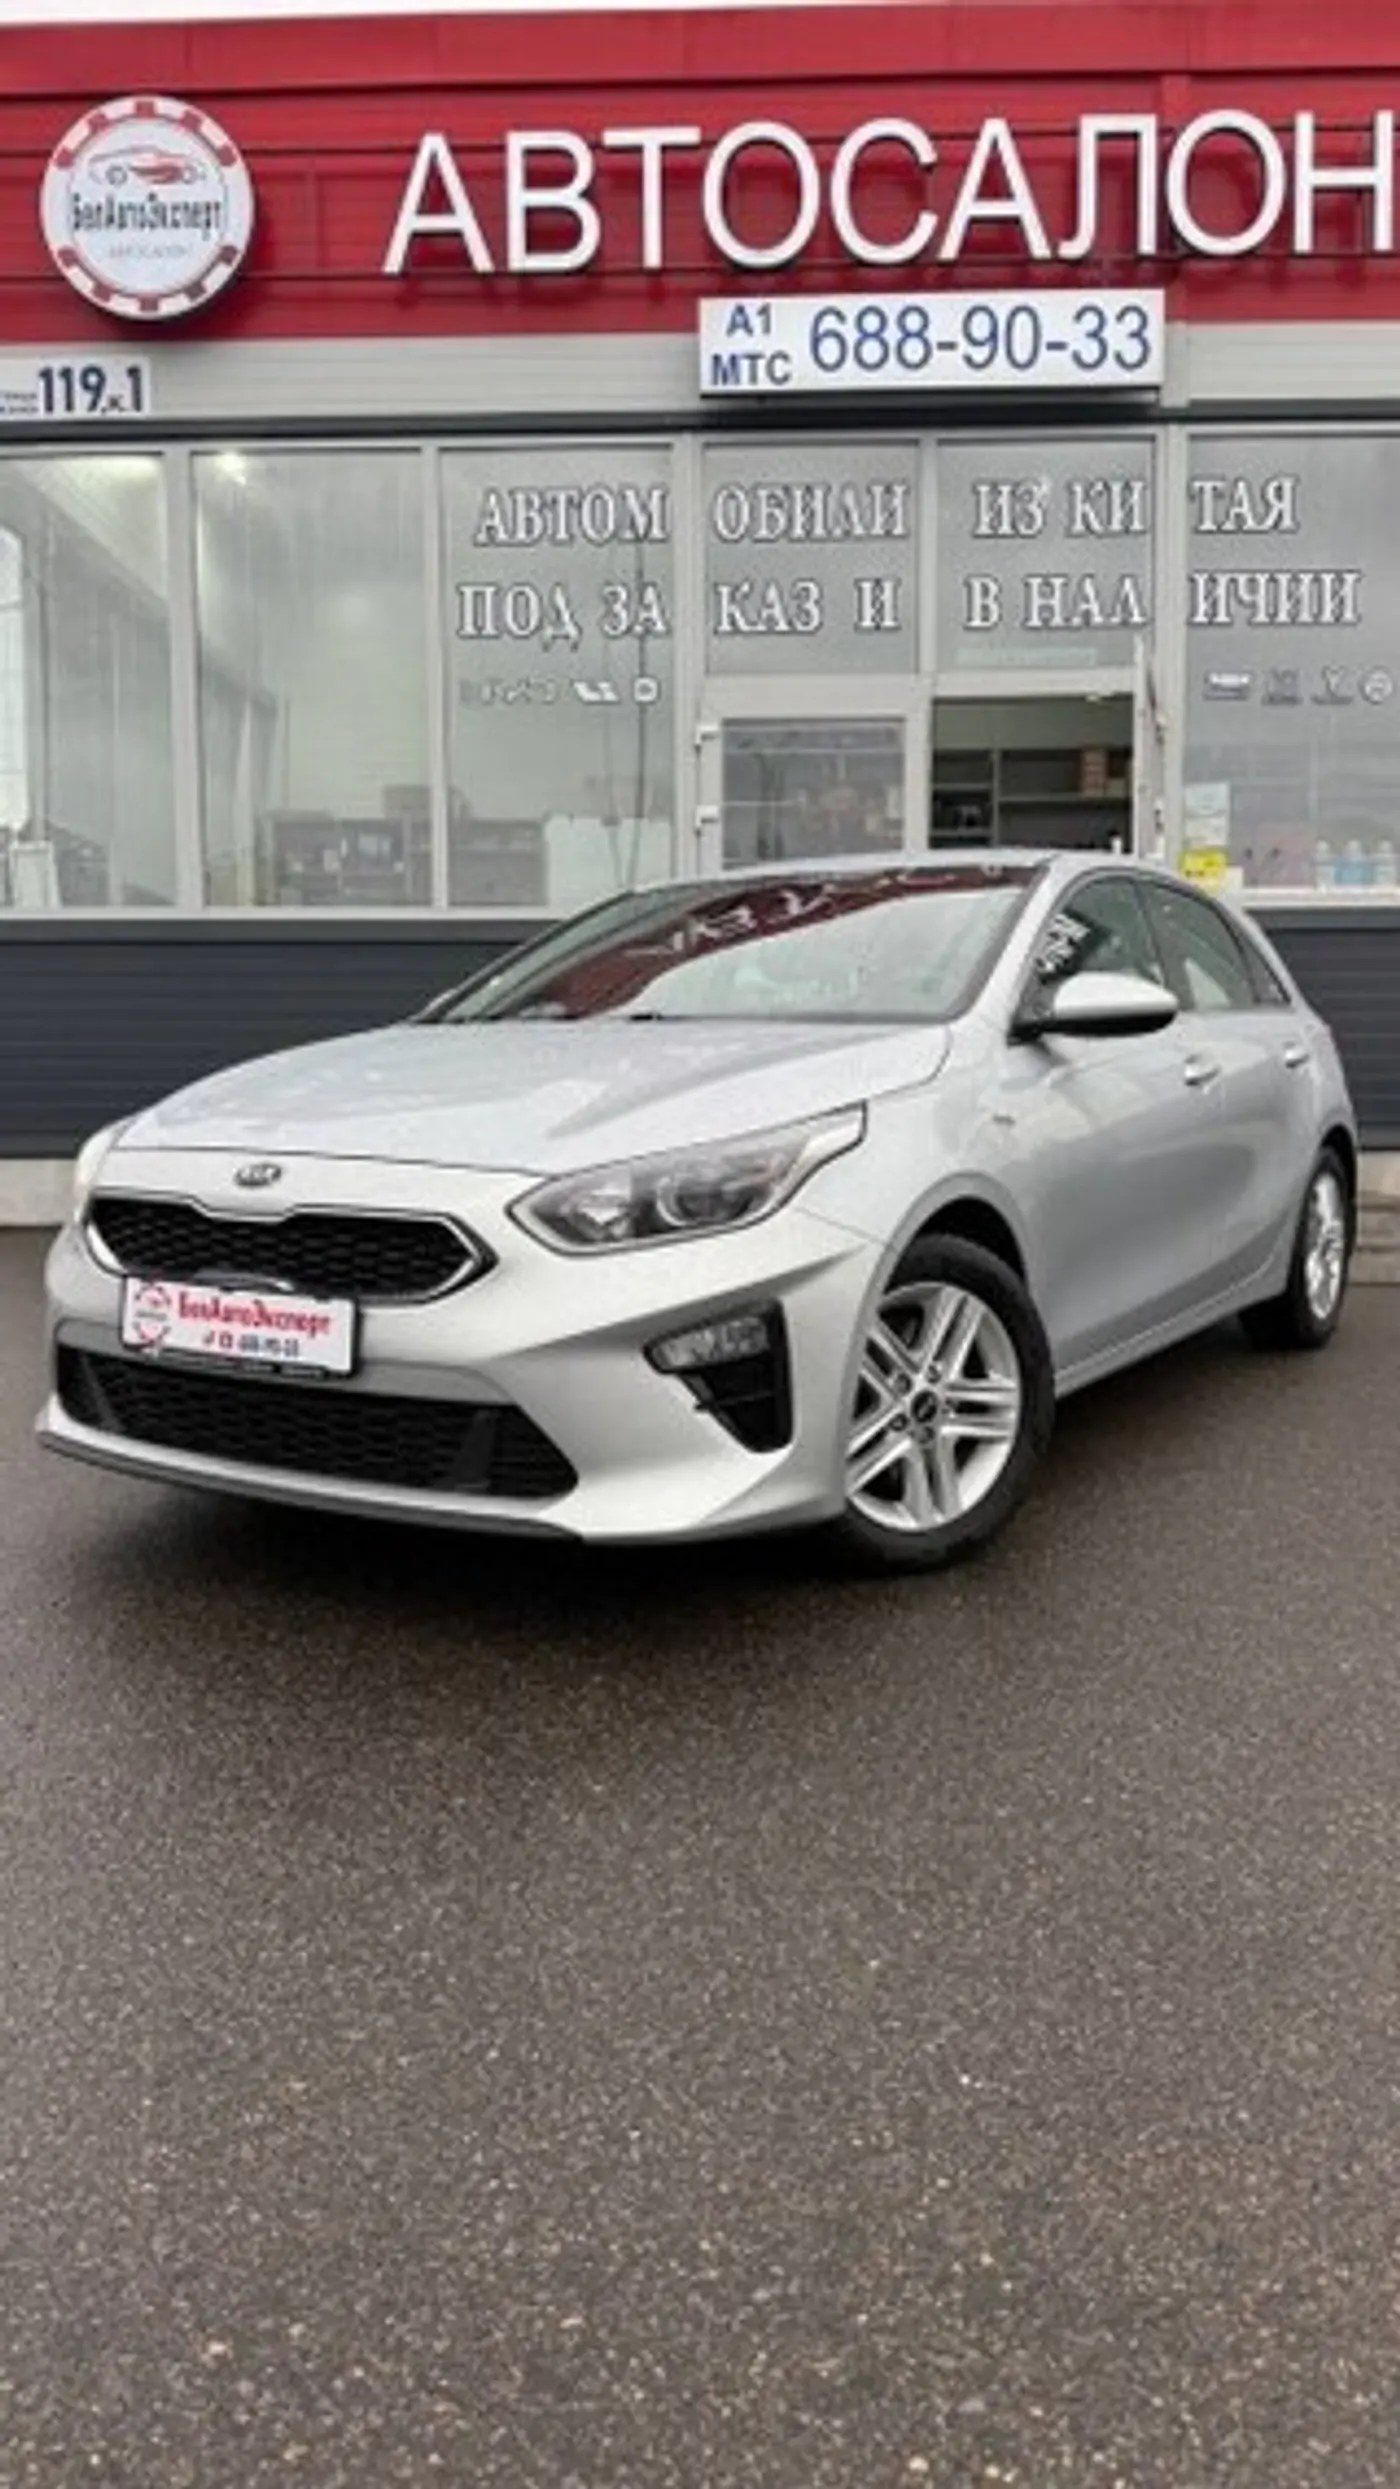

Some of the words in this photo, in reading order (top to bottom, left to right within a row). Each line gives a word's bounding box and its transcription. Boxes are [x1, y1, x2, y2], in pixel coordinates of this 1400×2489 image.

[382, 110, 1394, 269] АВТОСАЛОН
[710, 353, 792, 386] МТС
[809, 304, 1153, 373] 688-90-33
[457, 581, 582, 651] ПОД
[854, 579, 901, 632] И
[964, 577, 1002, 630] В
